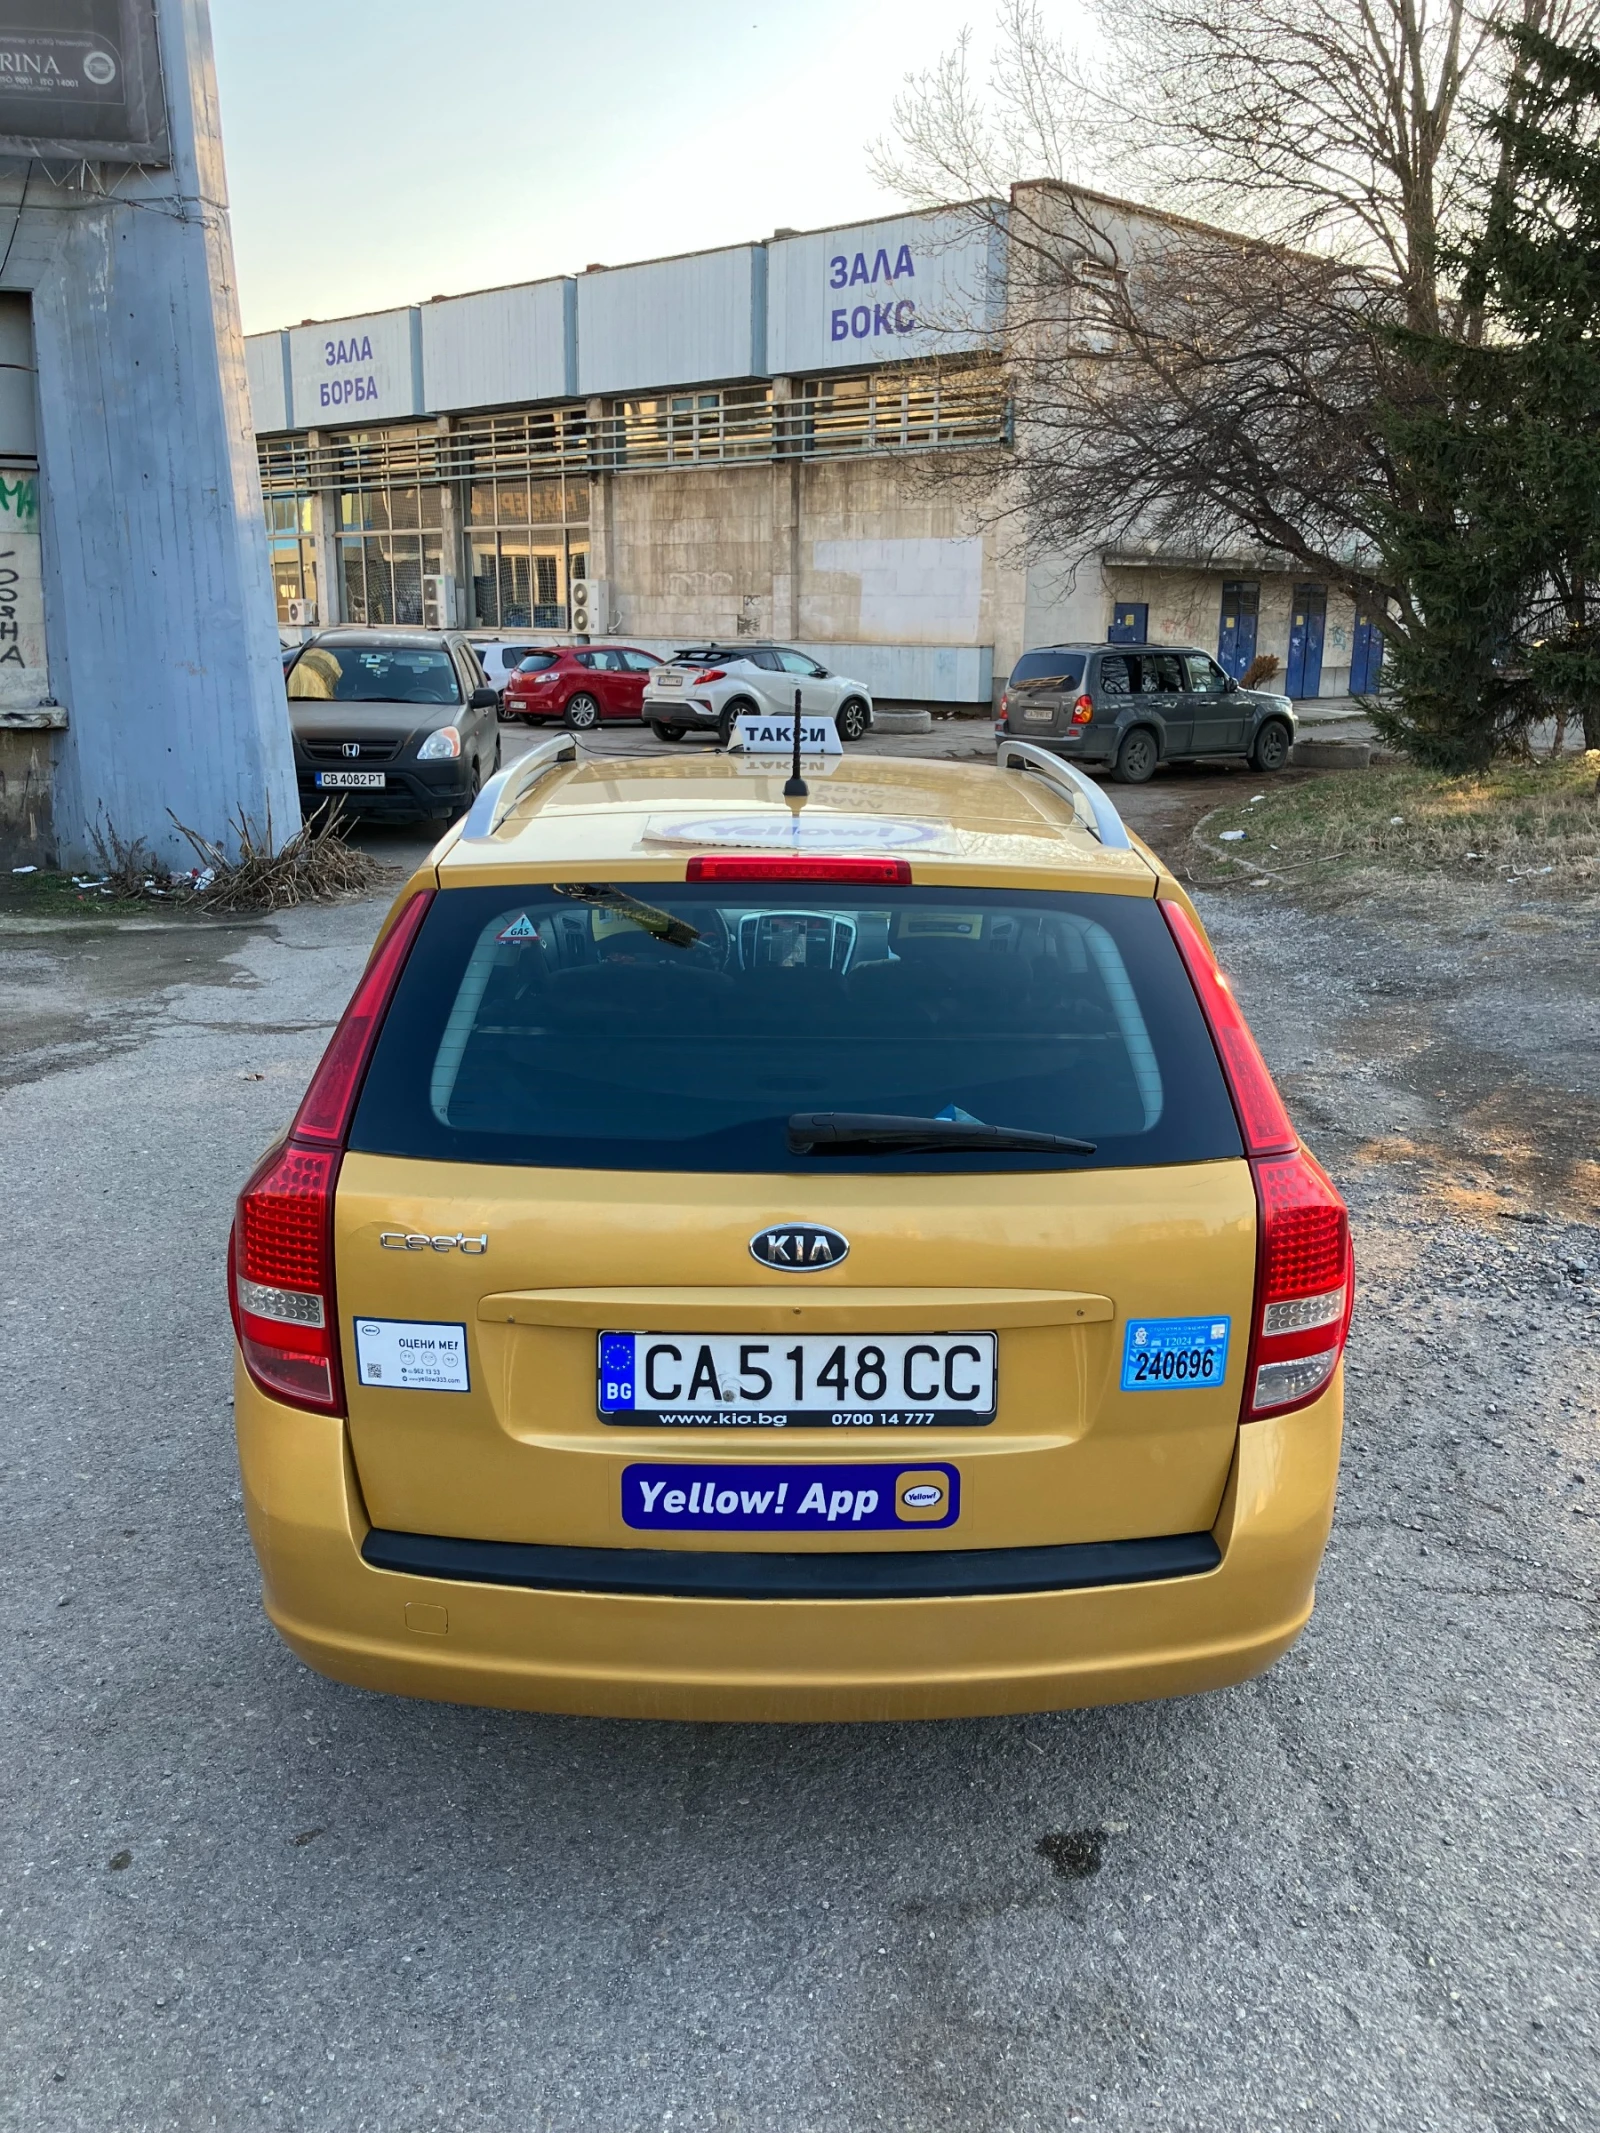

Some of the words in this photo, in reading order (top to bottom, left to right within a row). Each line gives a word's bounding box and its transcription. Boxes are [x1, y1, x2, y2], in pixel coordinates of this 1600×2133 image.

[829, 244, 915, 290] ЗАЛА
[831, 299, 916, 342] БОКС
[325, 335, 373, 366] ЗАЛА
[319, 375, 378, 407] БОРБА
[745, 727, 826, 742] ТАКСИ
[708, 824, 897, 837] Yellow!
[510, 927, 530, 936] GAS
[766, 1234, 834, 1262] KIA
[398, 1338, 435, 1350] ОЦЕНИ
[438, 1340, 459, 1351] МЕ!
[1134, 1348, 1215, 1381] 240696
[606, 1382, 633, 1400] BG
[659, 1413, 788, 1427] www.kia.bg
[831, 1413, 874, 1425] 0700
[880, 1413, 899, 1425] 14
[904, 1413, 935, 1425] 777
[639, 1481, 789, 1514] Yellow!
[797, 1482, 880, 1522] App
[908, 1491, 937, 1501] Yellow!
